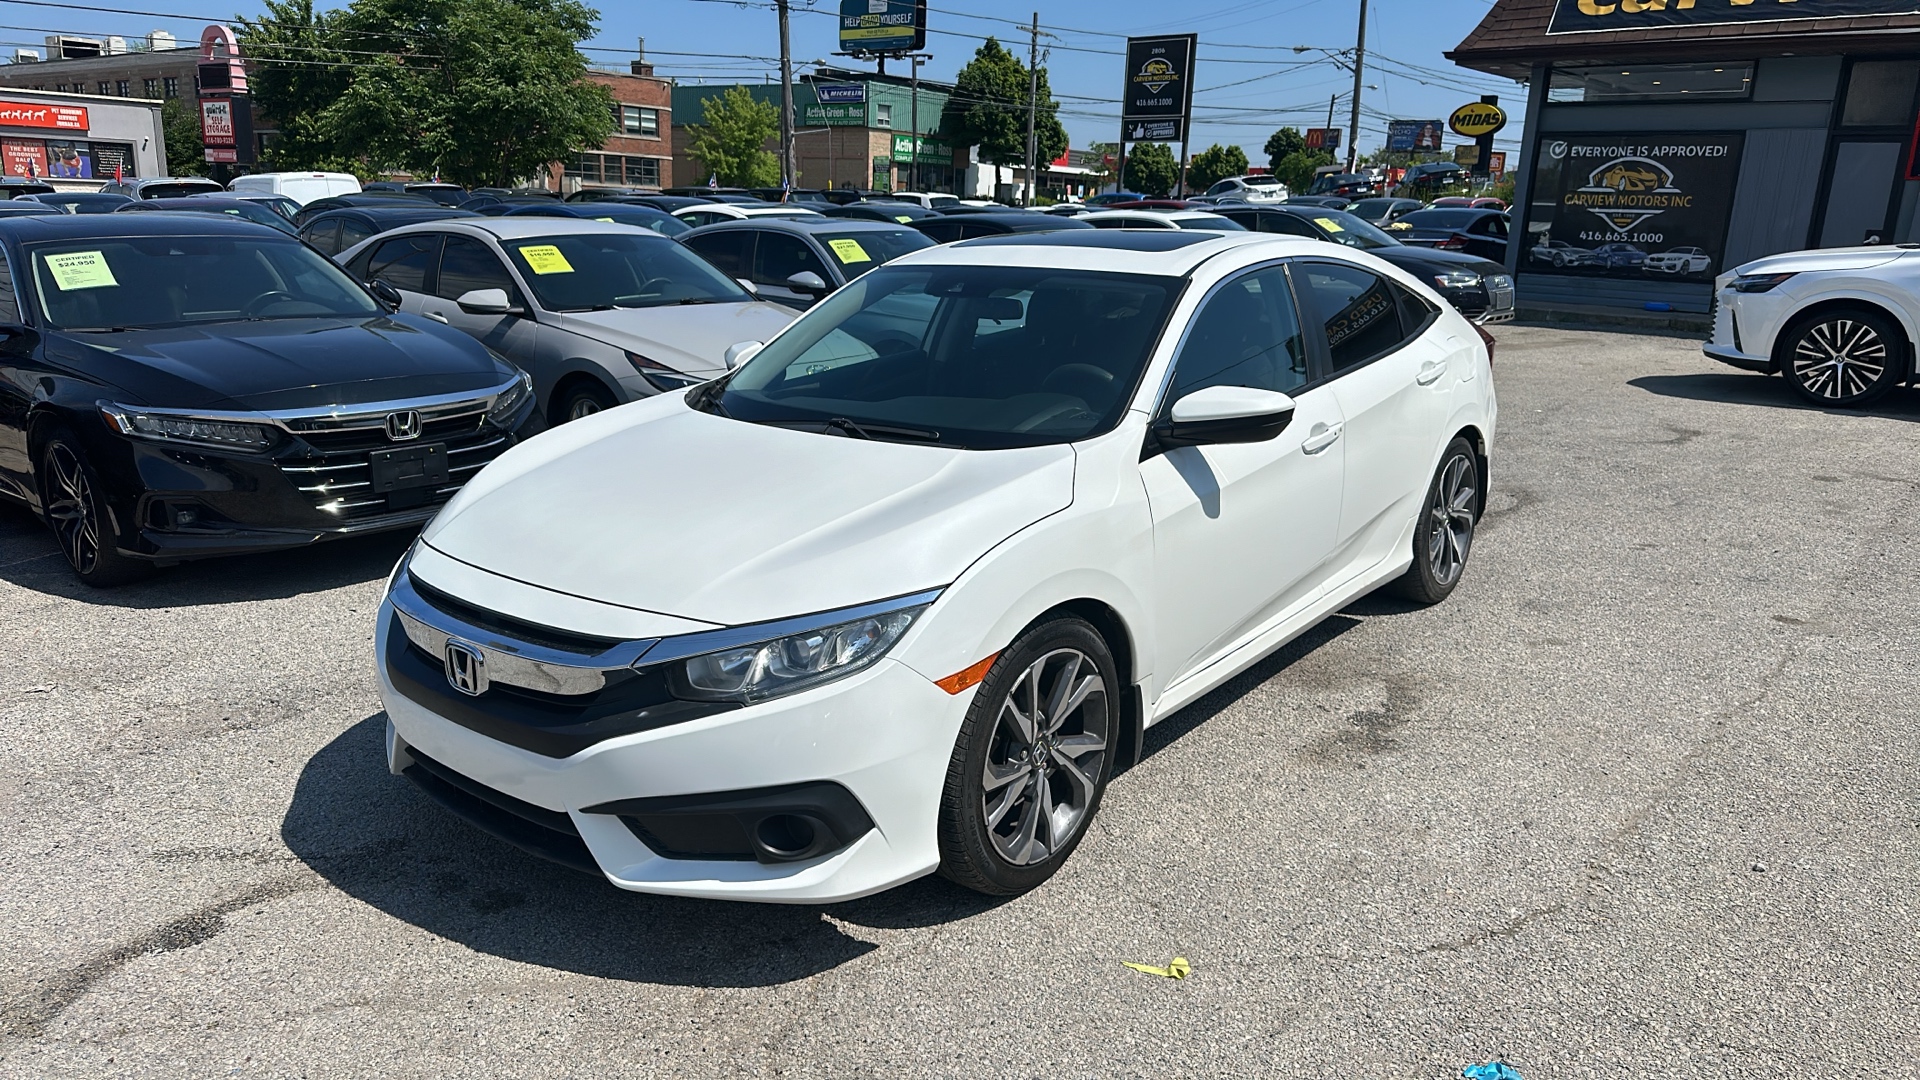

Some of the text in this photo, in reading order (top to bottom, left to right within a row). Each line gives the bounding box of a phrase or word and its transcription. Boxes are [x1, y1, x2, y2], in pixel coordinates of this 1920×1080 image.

[844, 17, 860, 27] HELP
[880, 13, 912, 24] YOURSELF
[1151, 47, 1166, 55] 2806
[1133, 75, 1152, 83] CARVIEW
[1153, 74, 1171, 82] MOTORS
[1136, 97, 1173, 107] 416.665.1000
[826, 107, 845, 118] Green
[848, 107, 864, 118] Ross
[211, 115, 223, 125] SELF
[1453, 112, 1500, 127] MIDAS
[206, 125, 231, 134] STORAGE
[895, 138, 913, 153] Activ
[916, 140, 934, 155] Green
[939, 143, 953, 156] Ross
[1571, 145, 1728, 157] EVERYONE IS APPROVED!
[1564, 194, 1693, 208] CARVIEW MOTORS INC
[1579, 231, 1664, 243] 416.665.1000
[55, 254, 95, 262] CERTIFIED
[58, 260, 96, 268] $24,950
[967, 815, 992, 869] Cinturato
